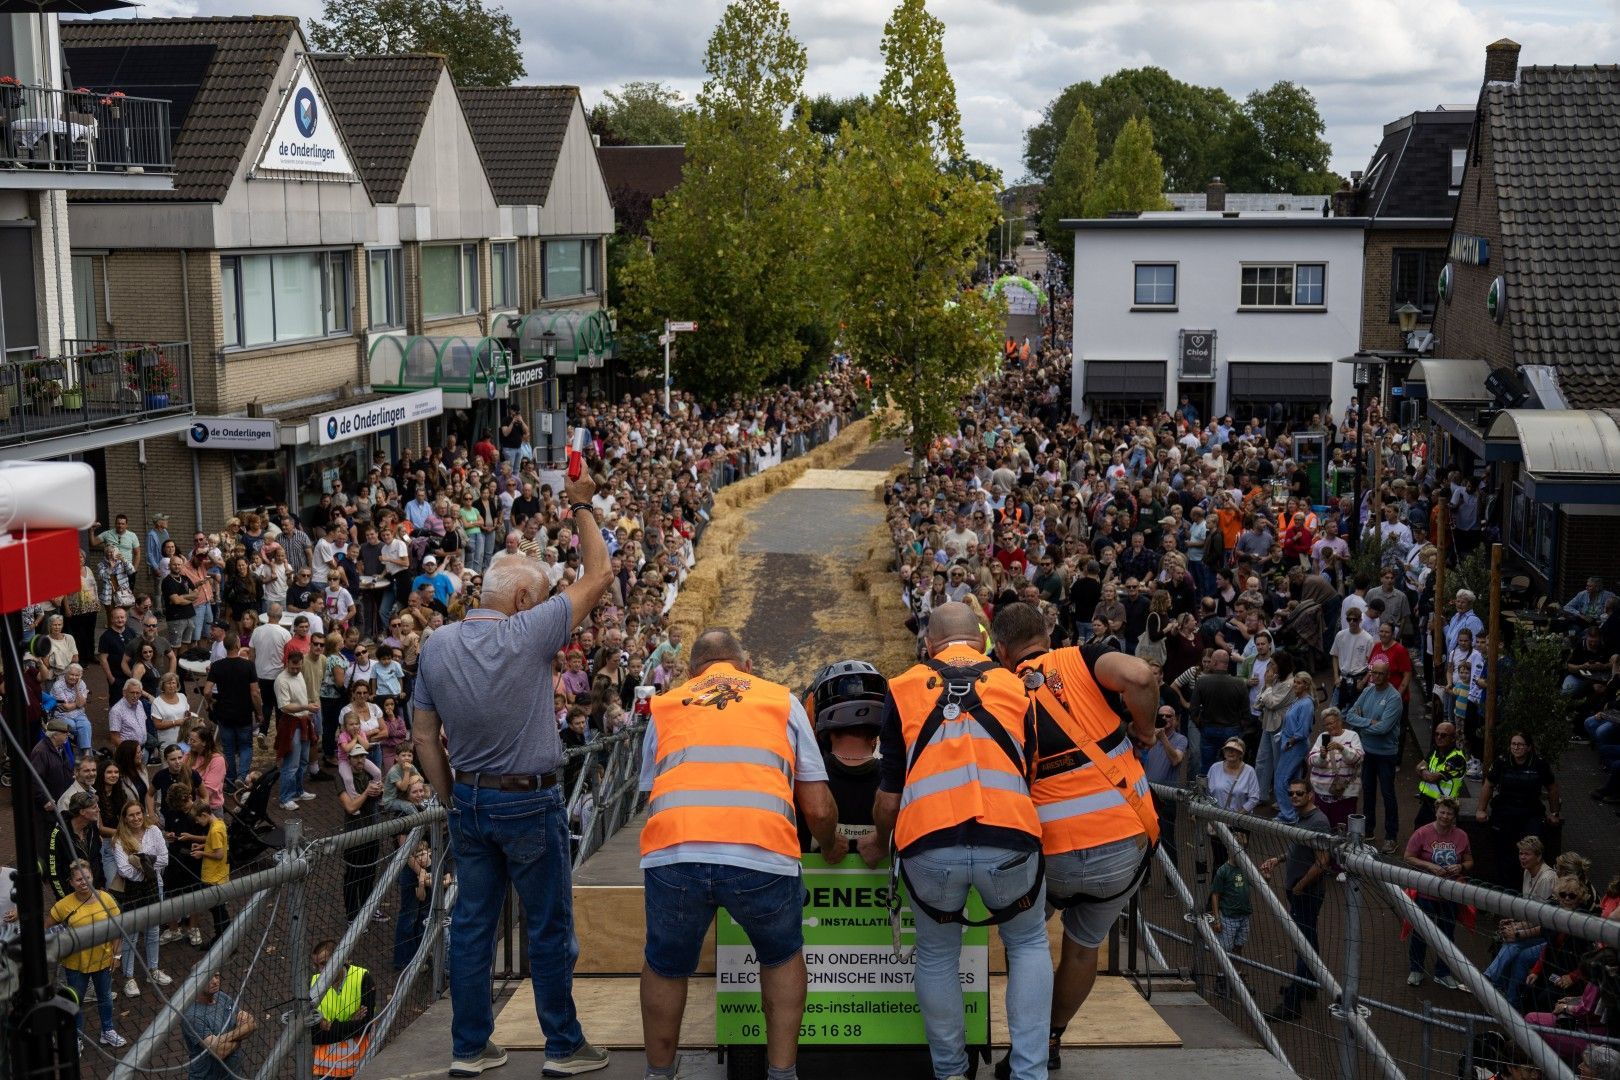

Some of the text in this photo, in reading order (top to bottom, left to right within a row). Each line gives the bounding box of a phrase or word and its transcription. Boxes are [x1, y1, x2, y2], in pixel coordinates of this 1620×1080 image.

[279, 141, 335, 161] de Onderlingen
[1186, 348, 1209, 356] Chloé
[510, 366, 543, 387] kappers
[340, 416, 351, 435] de
[353, 406, 406, 430] Onderlingen
[210, 428, 271, 439] de Onderlingen
[1434, 850, 1456, 865] 66
[805, 953, 824, 965] EN
[720, 972, 876, 984] ELECCHNISCHE
[742, 1024, 760, 1037] 06
[821, 1024, 839, 1037] 16
[843, 1024, 862, 1037] 38
